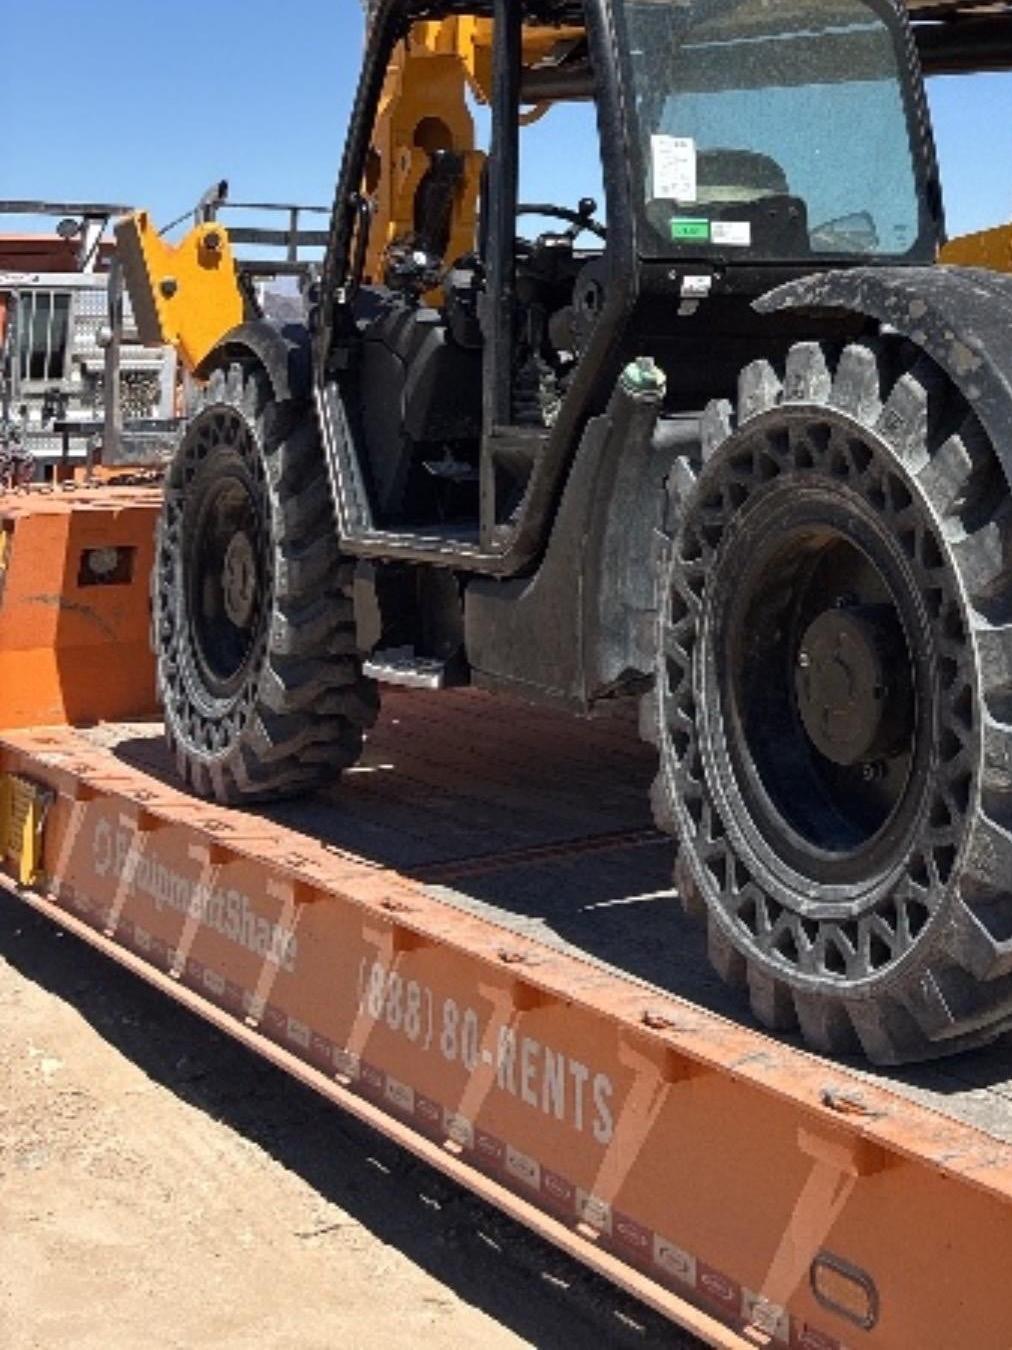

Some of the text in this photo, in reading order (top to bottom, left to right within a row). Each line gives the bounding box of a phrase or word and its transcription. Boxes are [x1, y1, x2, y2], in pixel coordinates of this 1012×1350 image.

[113, 830, 298, 972] EquipmentShare
[357, 956, 614, 1145] (888) 80-RENTS
